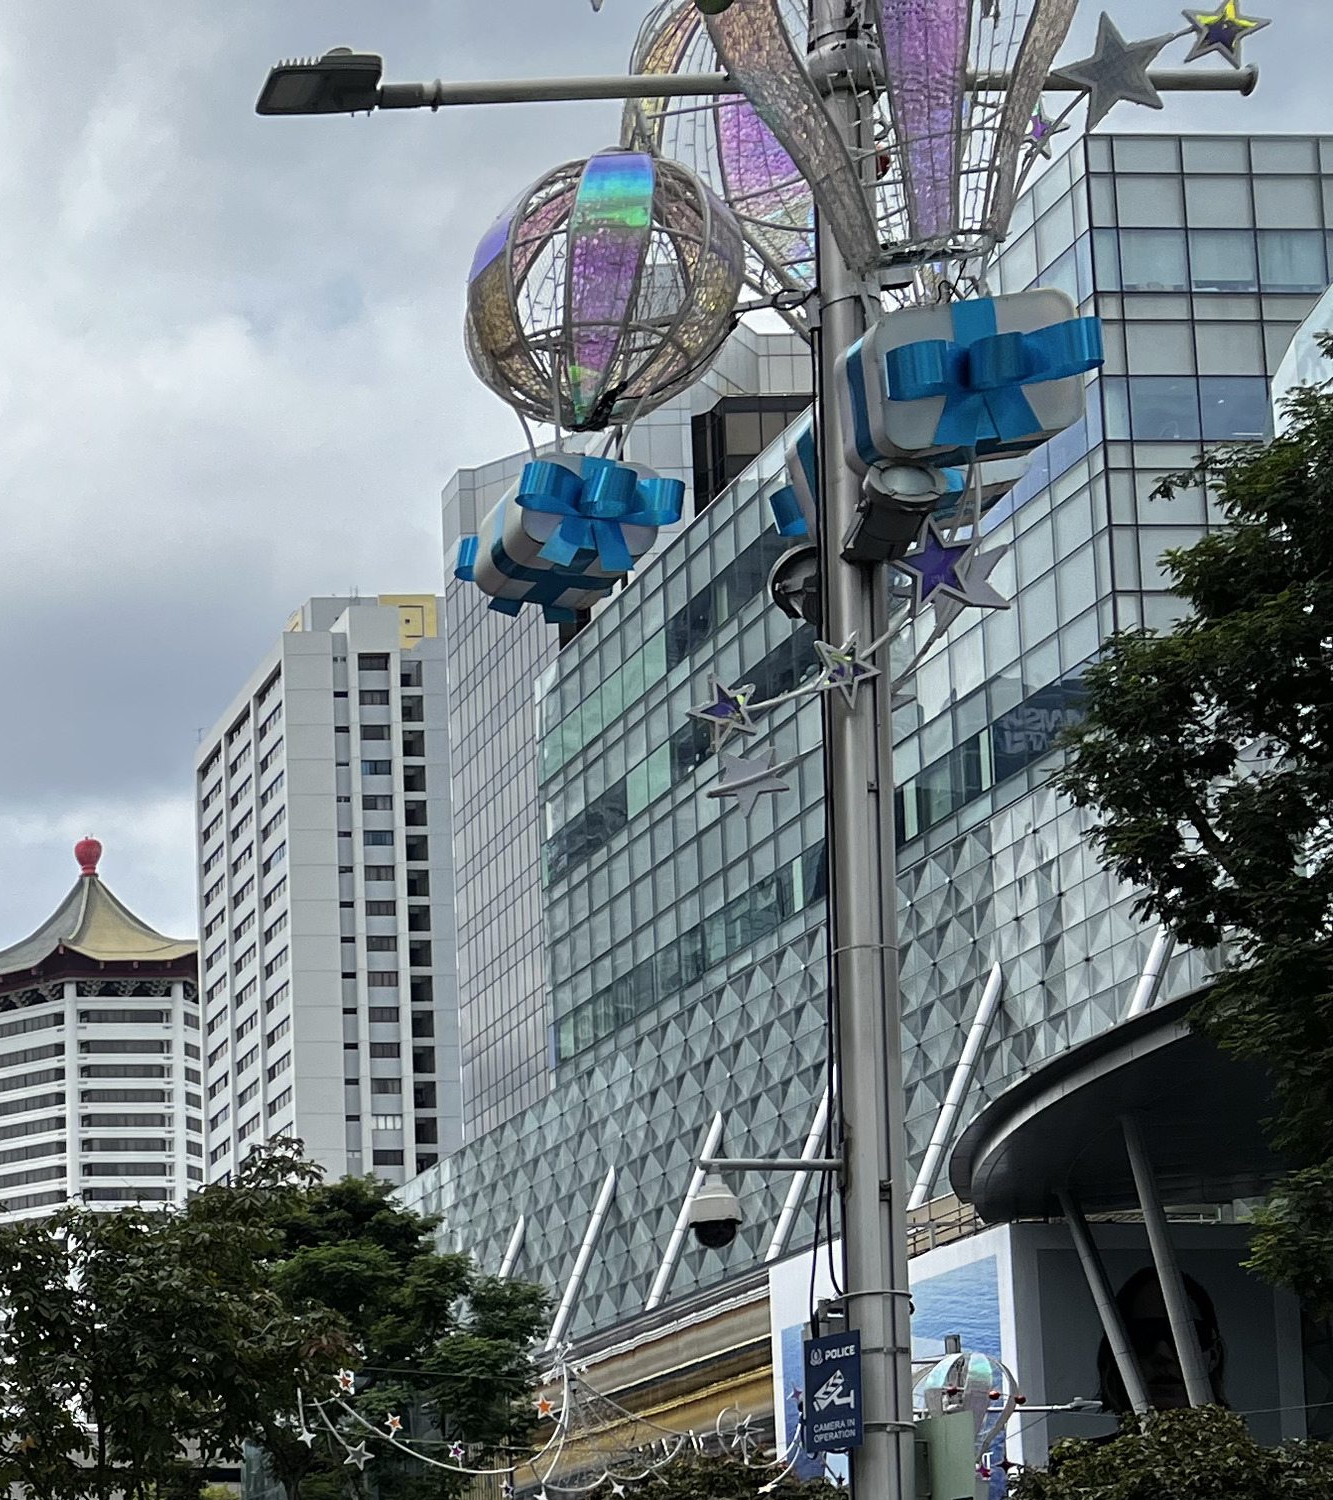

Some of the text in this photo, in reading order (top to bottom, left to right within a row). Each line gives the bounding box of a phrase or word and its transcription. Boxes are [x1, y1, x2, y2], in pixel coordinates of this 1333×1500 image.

[825, 1345, 855, 1360] POLICE
[814, 1420, 845, 1433] CAMERA
[813, 1429, 856, 1443] OPERATION
